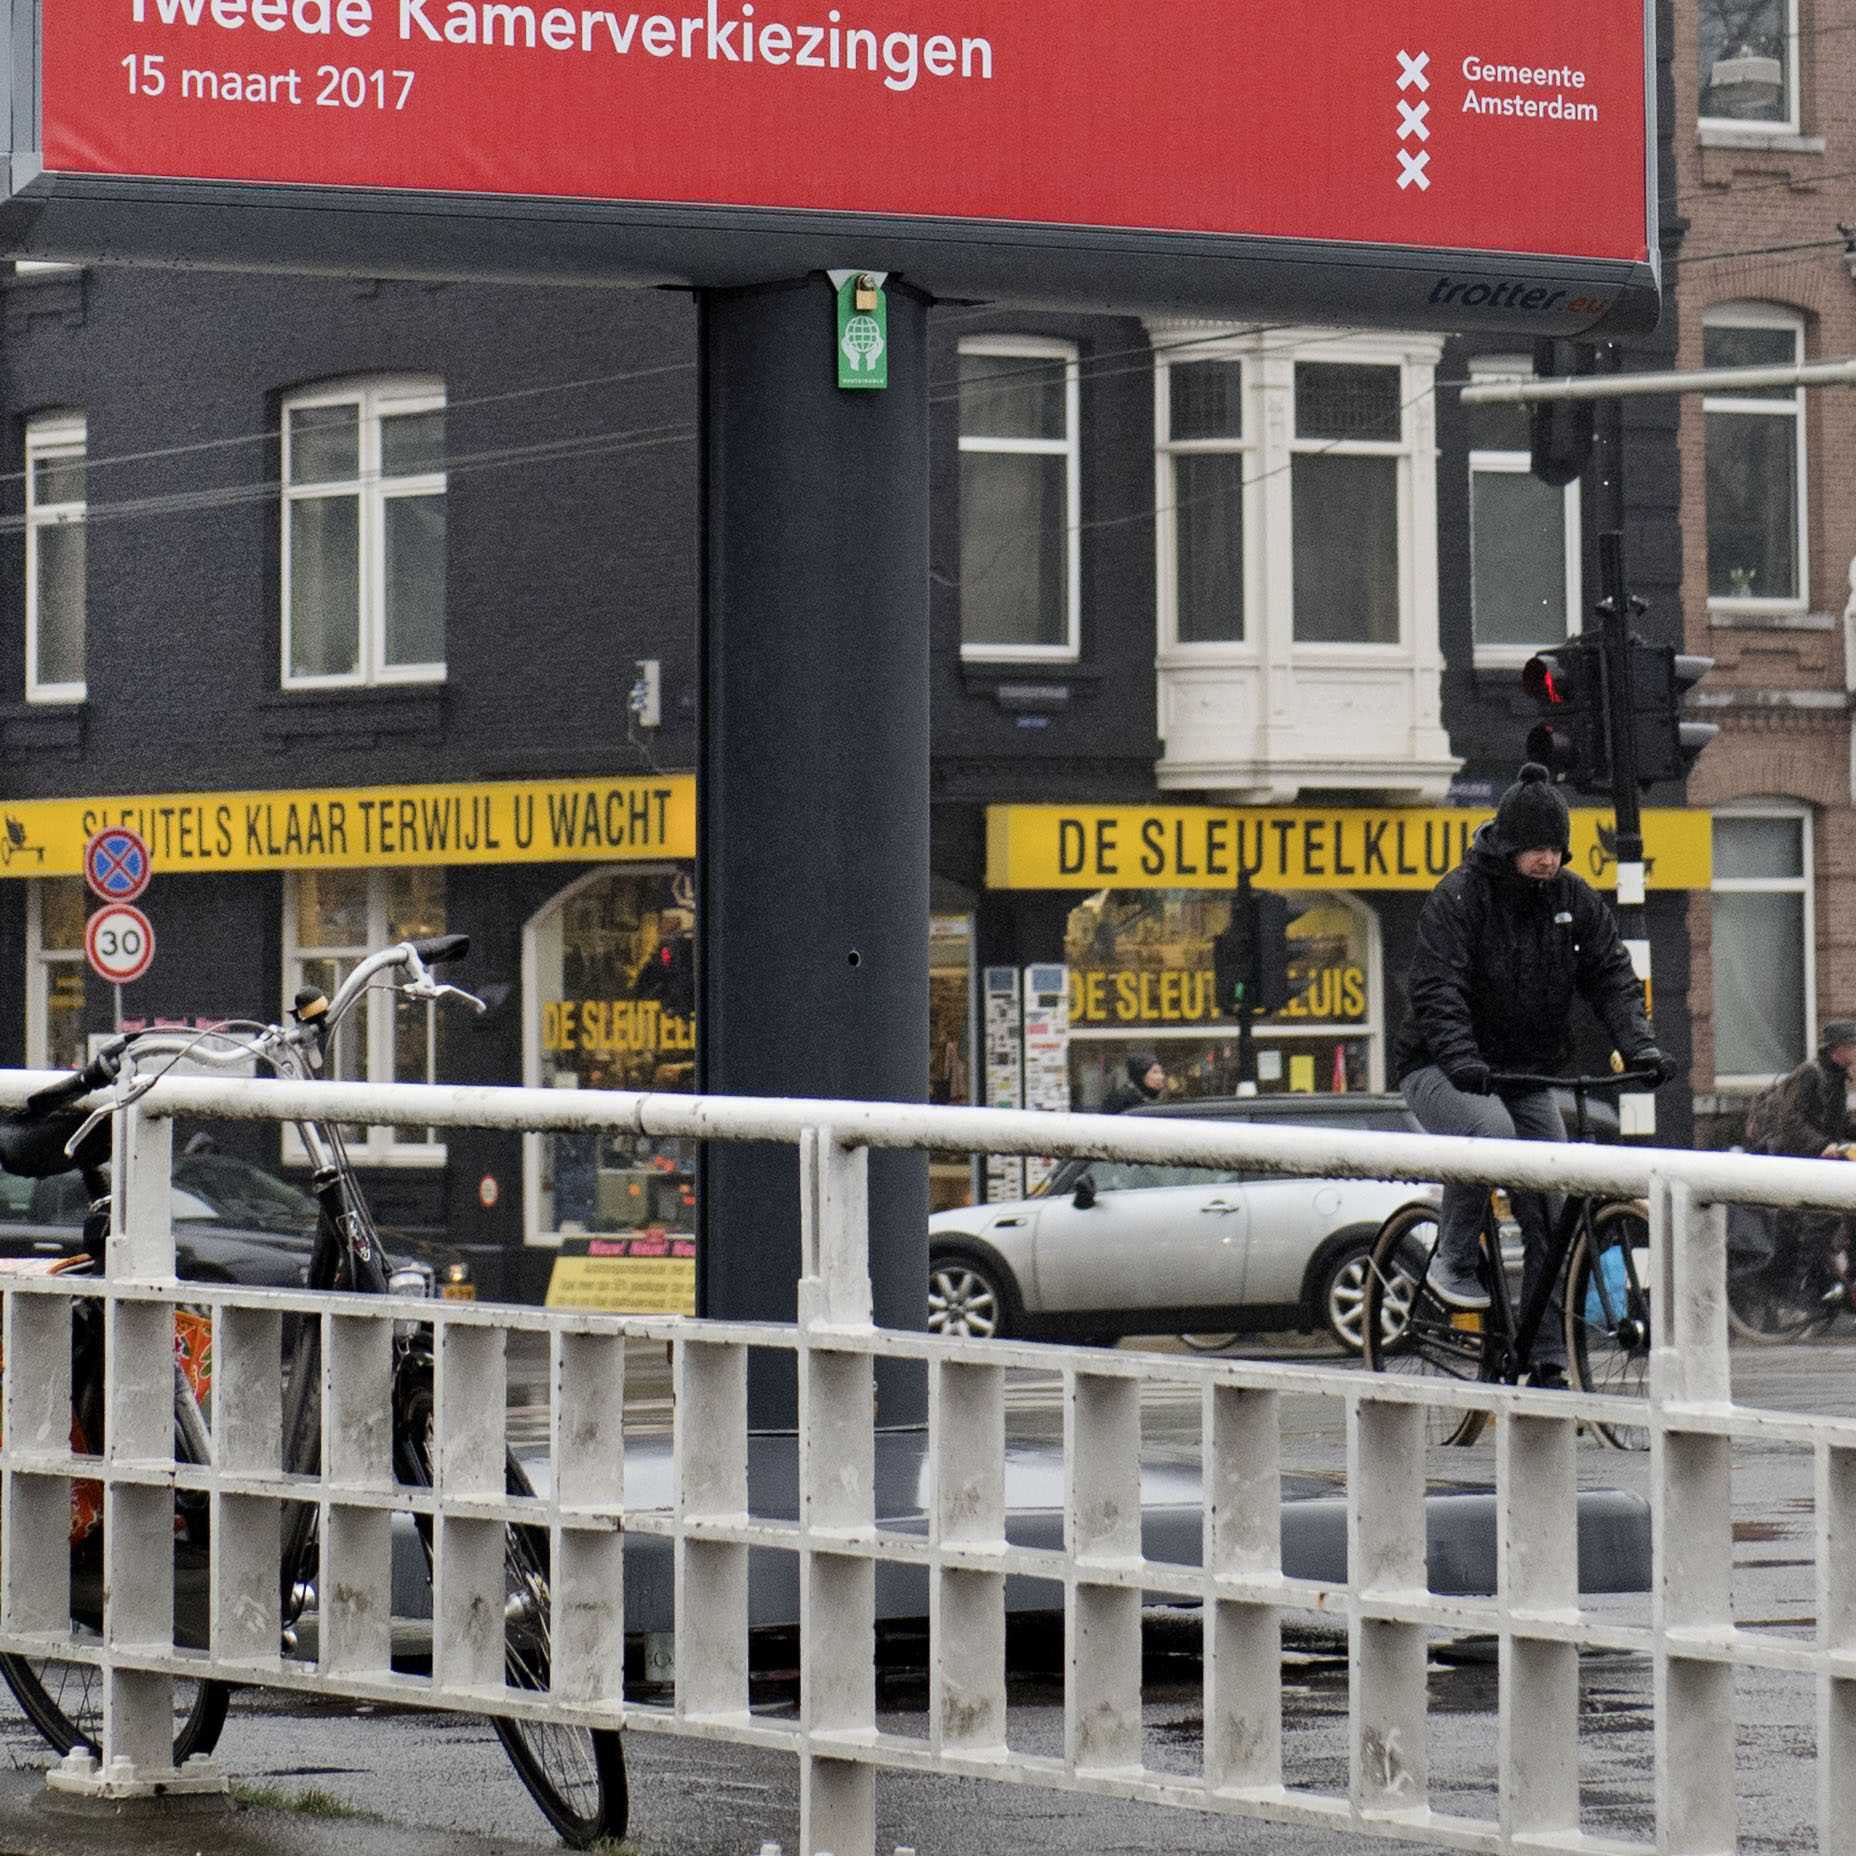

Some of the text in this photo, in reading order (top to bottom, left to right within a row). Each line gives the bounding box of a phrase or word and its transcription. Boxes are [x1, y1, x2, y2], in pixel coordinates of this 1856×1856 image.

[119, 52, 416, 111] 15 maart 2017
[1462, 56, 1585, 88] Gemeente
[1462, 89, 1598, 121] Amsterdam
[1426, 277, 1604, 314] trotter.eu
[245, 802, 347, 856] KLAAR
[358, 796, 500, 853] TERWIJL
[514, 794, 533, 849] U
[548, 789, 672, 848] WACHT
[1058, 819, 1469, 876] DE SLEUTELKLUI
[101, 930, 141, 956] 30
[543, 1000, 575, 1050] DE
